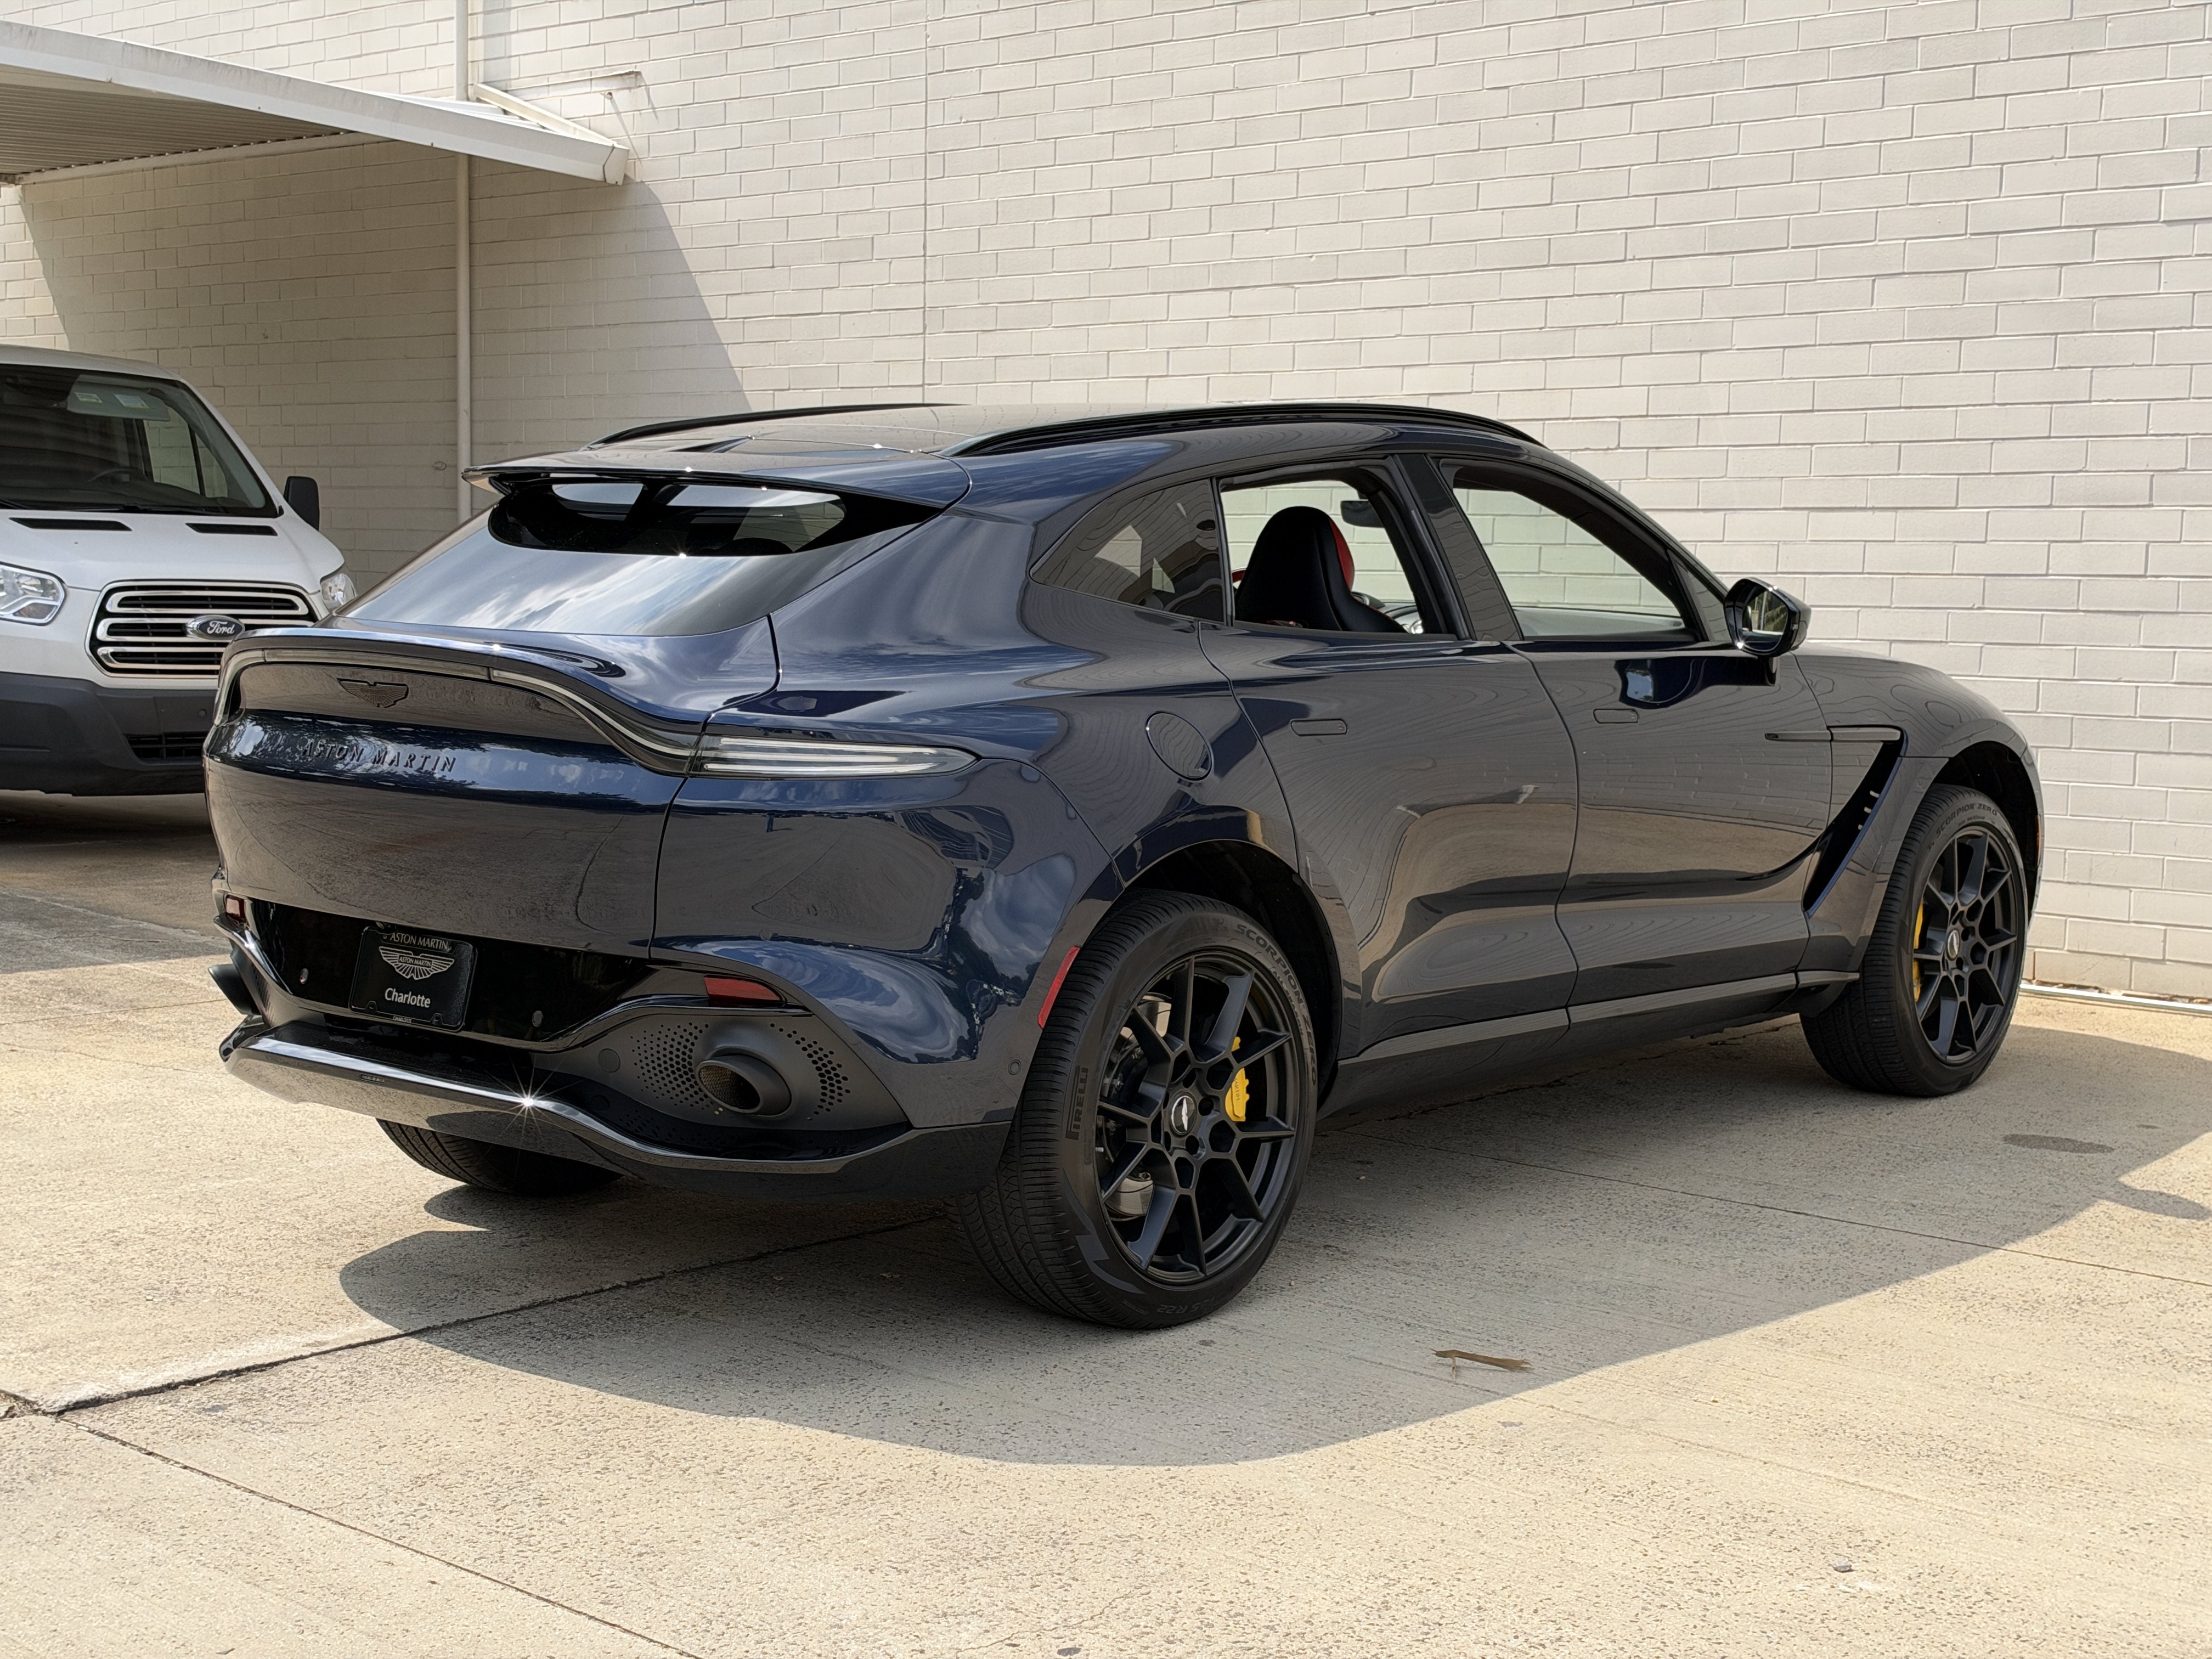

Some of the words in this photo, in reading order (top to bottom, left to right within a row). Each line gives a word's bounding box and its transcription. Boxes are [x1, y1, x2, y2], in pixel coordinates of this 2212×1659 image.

[207, 620, 235, 634] Ford
[302, 738, 364, 763] ASTON
[372, 749, 456, 772] MARTIN
[1936, 803, 1975, 839] SCORPION
[1977, 802, 1997, 816] ZERO
[390, 933, 417, 945] ASTON
[417, 937, 449, 951] MARTIN
[399, 956, 414, 964] ASTON
[385, 988, 431, 1008] Charlotte
[1235, 924, 1304, 1005] SCORPION
[1302, 1014, 1317, 1086] ZERO
[1065, 1065, 1088, 1141] PIRELLI
